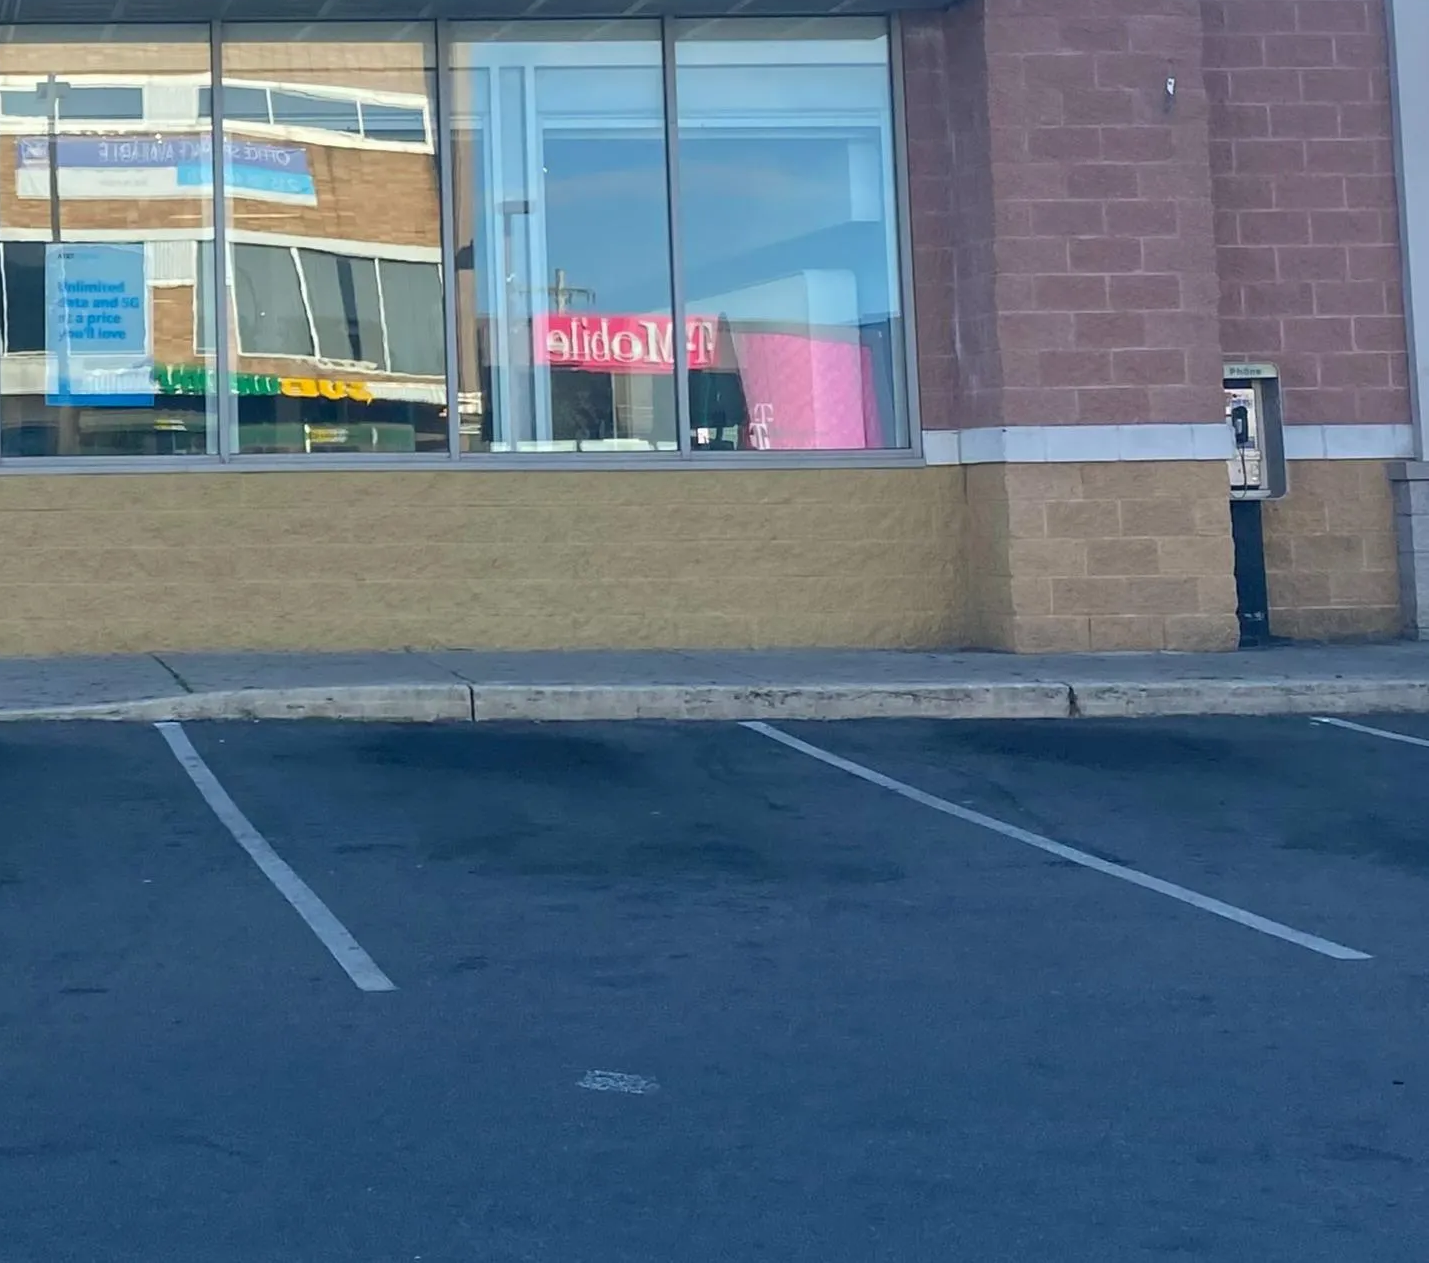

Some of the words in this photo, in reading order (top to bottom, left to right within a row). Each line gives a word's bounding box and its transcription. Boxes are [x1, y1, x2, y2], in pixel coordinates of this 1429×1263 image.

[57, 281, 125, 293] Unlimited
[93, 297, 118, 308] and
[87, 311, 122, 327] price
[98, 327, 126, 339] love
